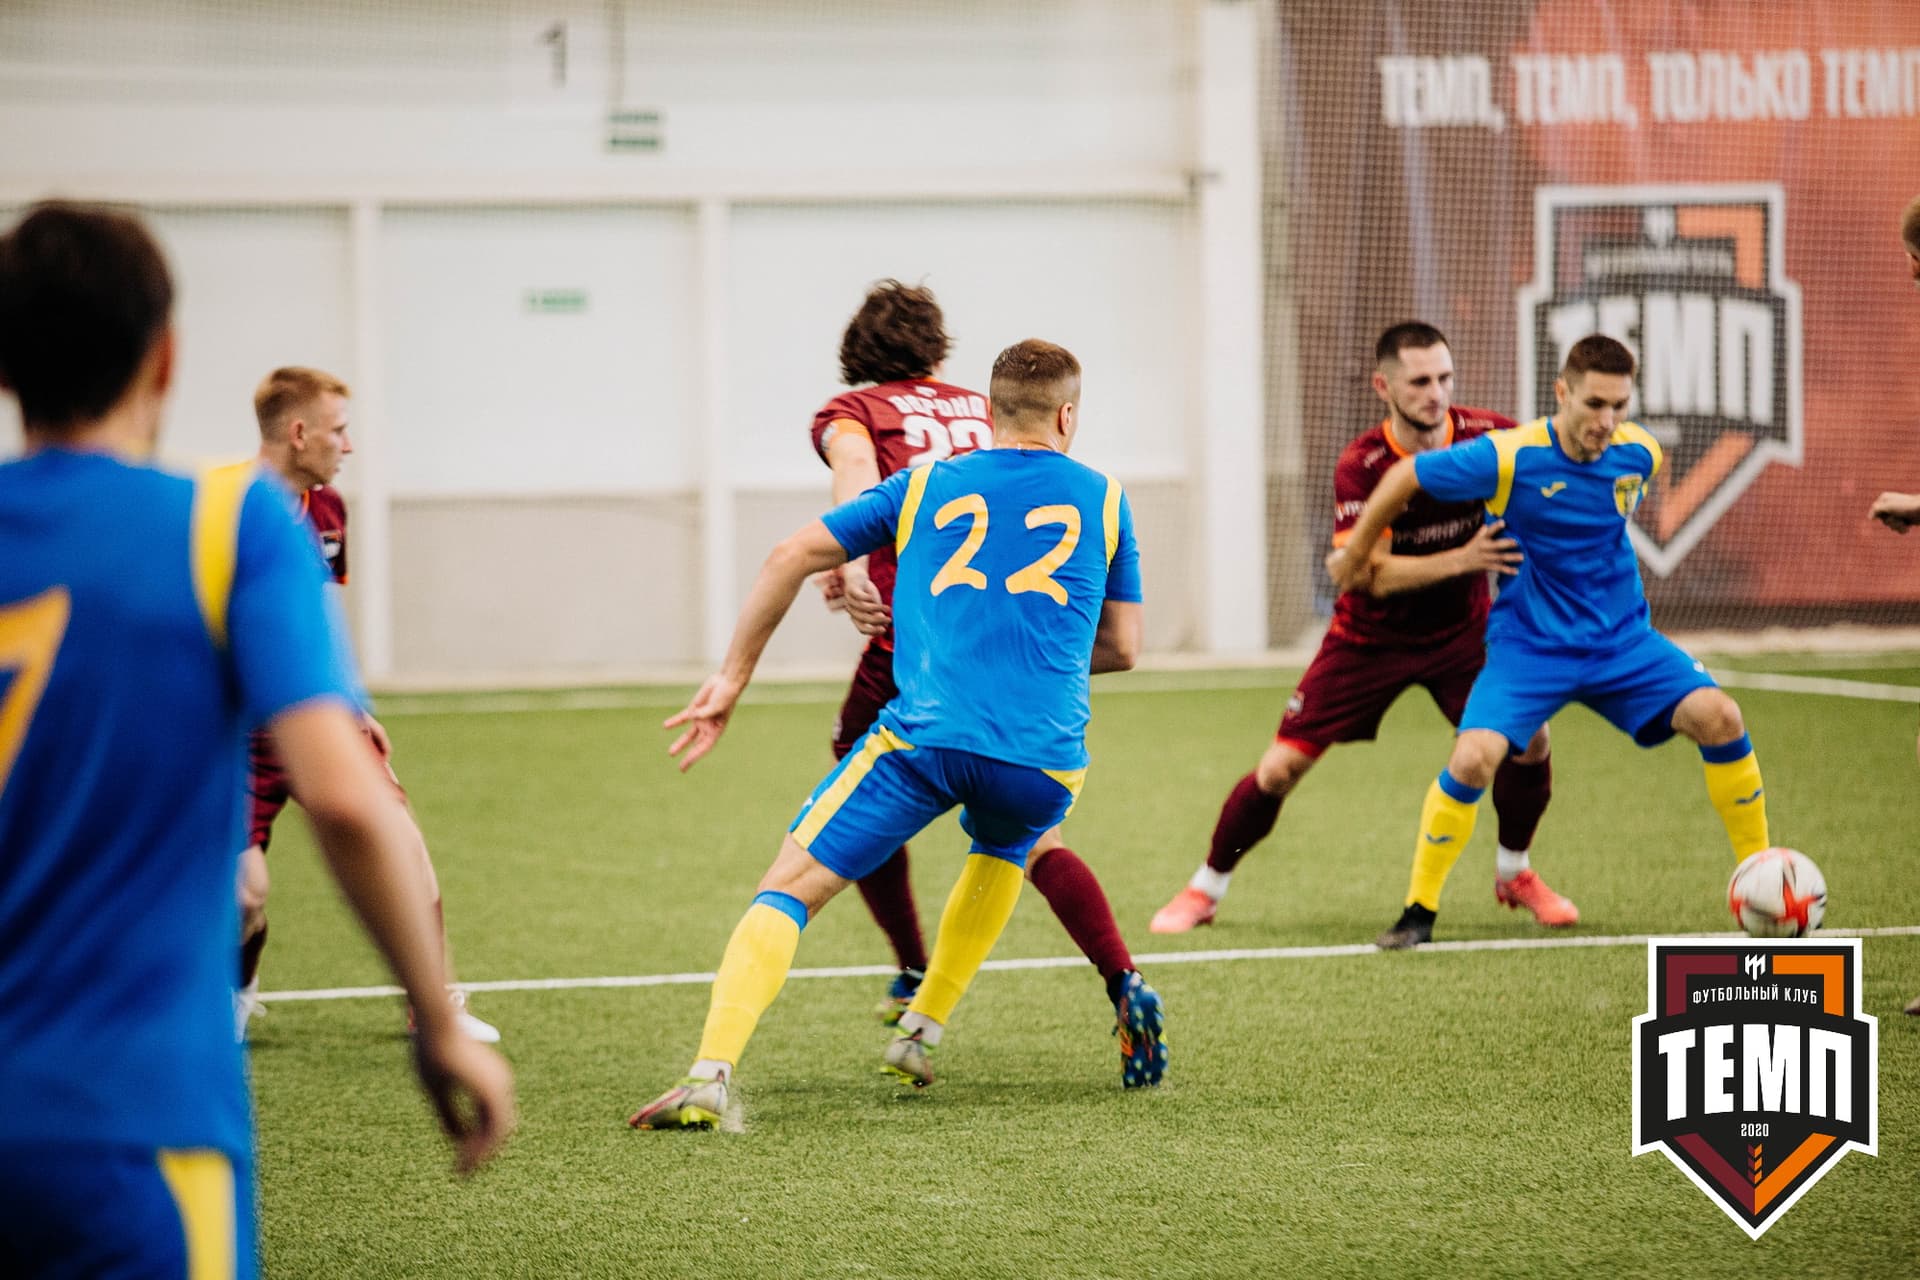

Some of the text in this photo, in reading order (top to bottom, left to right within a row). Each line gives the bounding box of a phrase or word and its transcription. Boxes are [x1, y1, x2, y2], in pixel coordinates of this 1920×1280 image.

[1381, 55, 1504, 132] ТЕМП,
[1511, 52, 1638, 130] ТЕМП,
[1647, 51, 1811, 122] ТОЛЬКО
[930, 493, 1082, 606] 22
